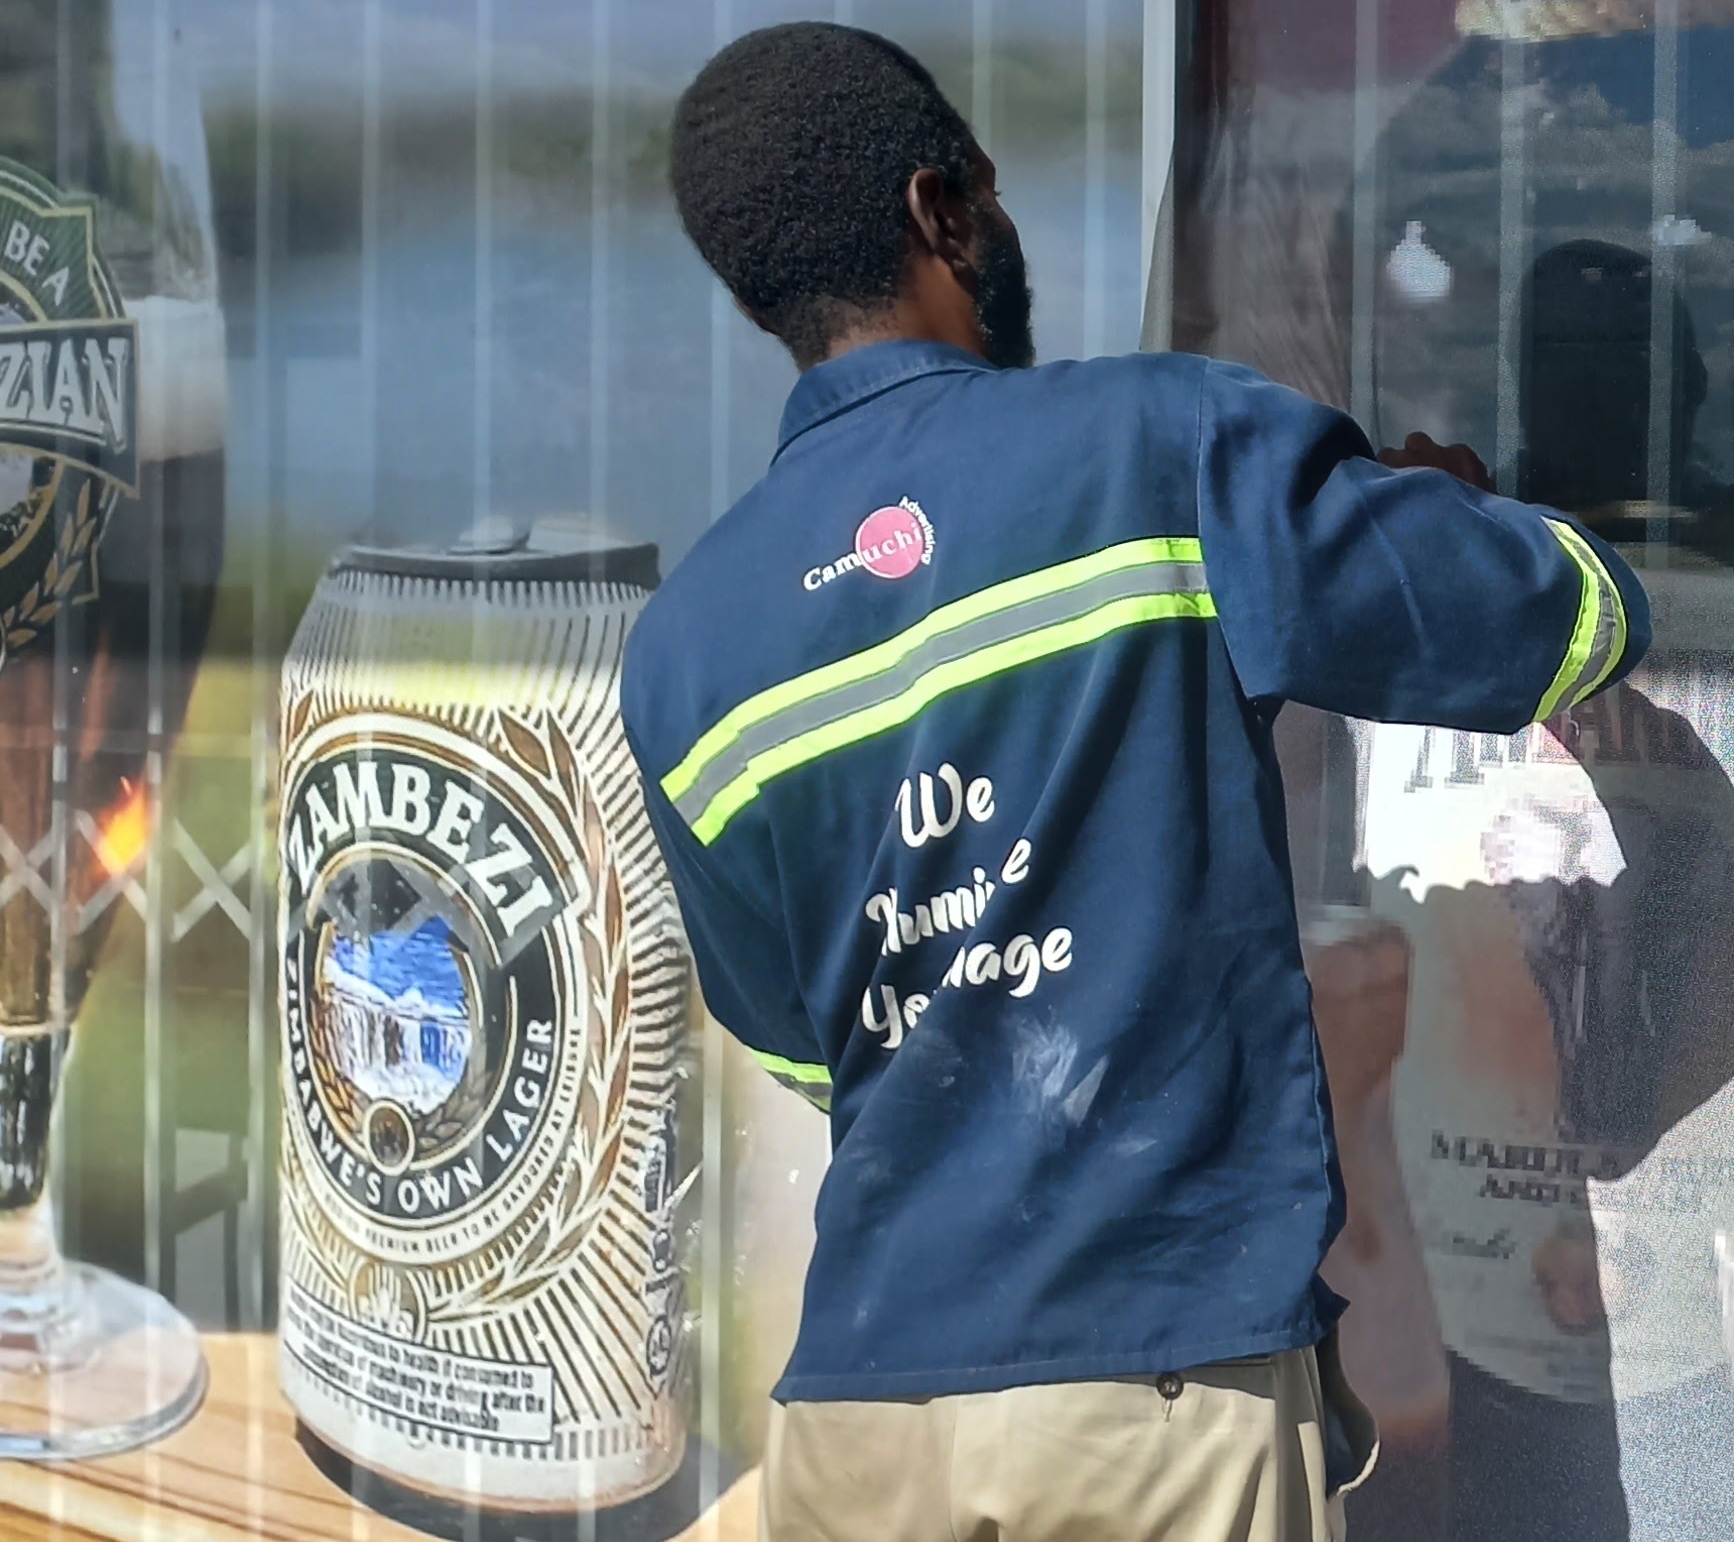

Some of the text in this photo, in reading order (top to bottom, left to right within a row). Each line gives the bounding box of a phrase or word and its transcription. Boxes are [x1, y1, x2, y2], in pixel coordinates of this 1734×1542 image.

[4, 219, 70, 306] BE A
[803, 522, 922, 591] Camuchi
[899, 495, 936, 565] Advertising
[896, 762, 995, 848] We
[289, 761, 553, 937] ZAMBEZI
[397, 1156, 484, 1214] OWN
[486, 1019, 553, 1162] LAGER
